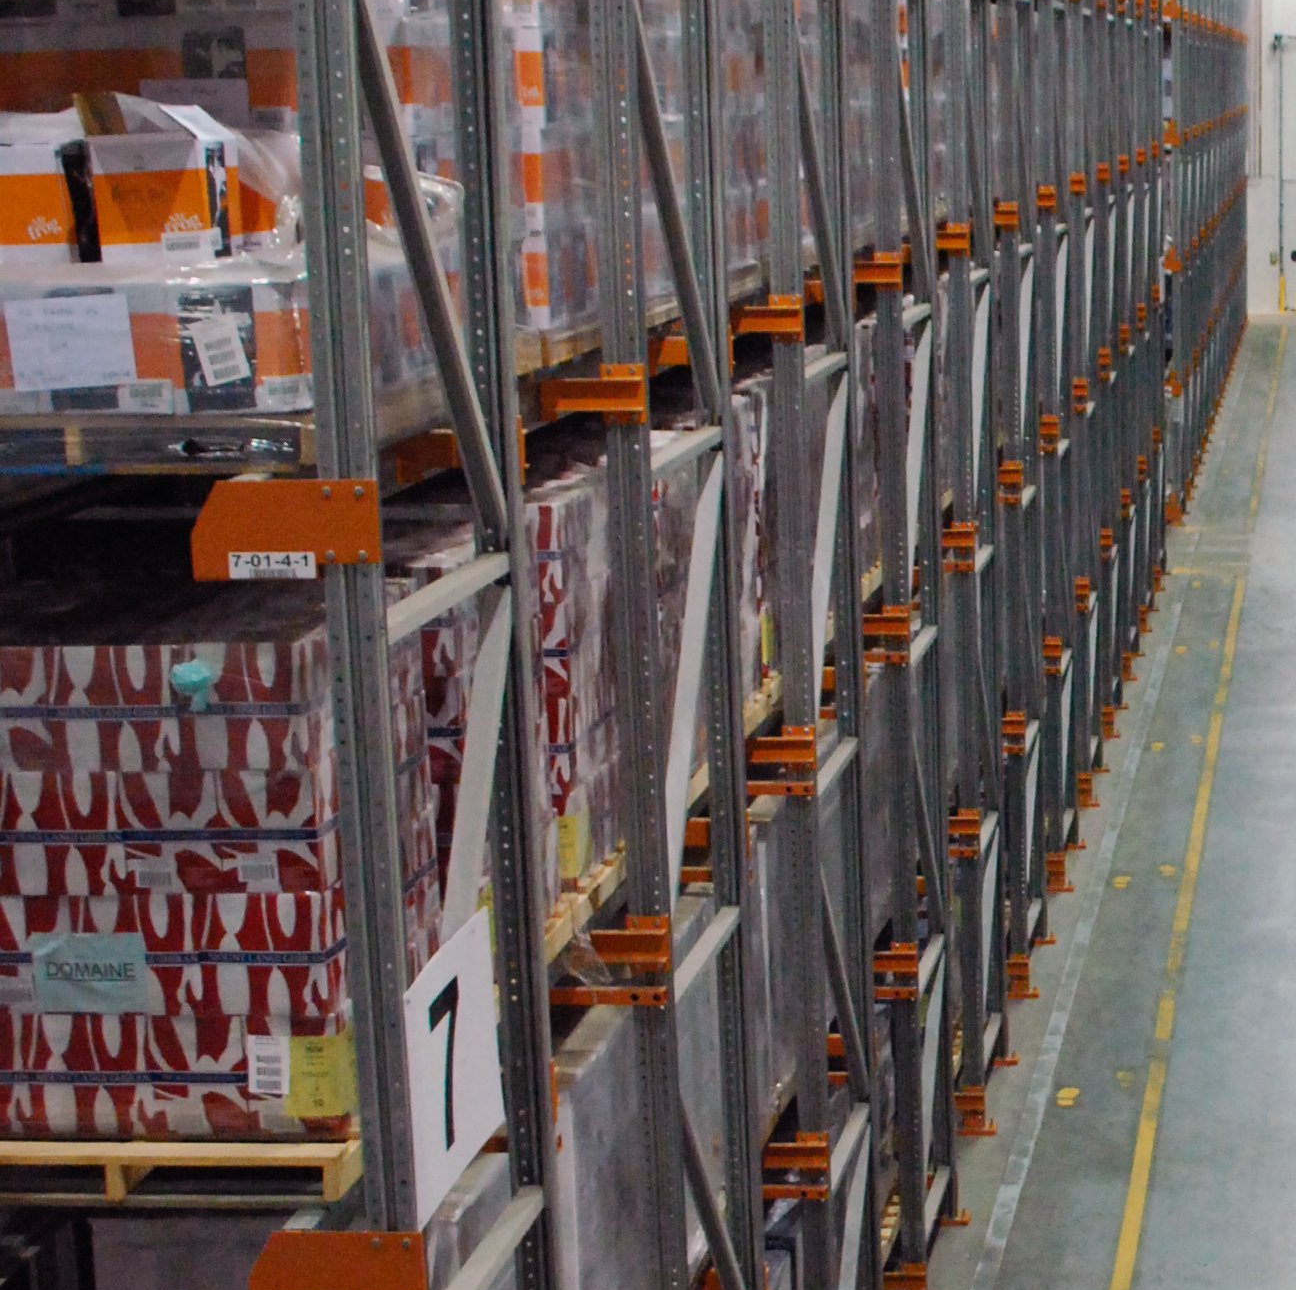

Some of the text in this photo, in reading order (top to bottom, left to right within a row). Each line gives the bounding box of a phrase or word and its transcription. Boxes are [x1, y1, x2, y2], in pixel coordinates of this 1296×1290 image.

[231, 554, 309, 568] 7-01-4-1
[46, 961, 135, 979] DOMAINE
[428, 974, 459, 1152] 7
